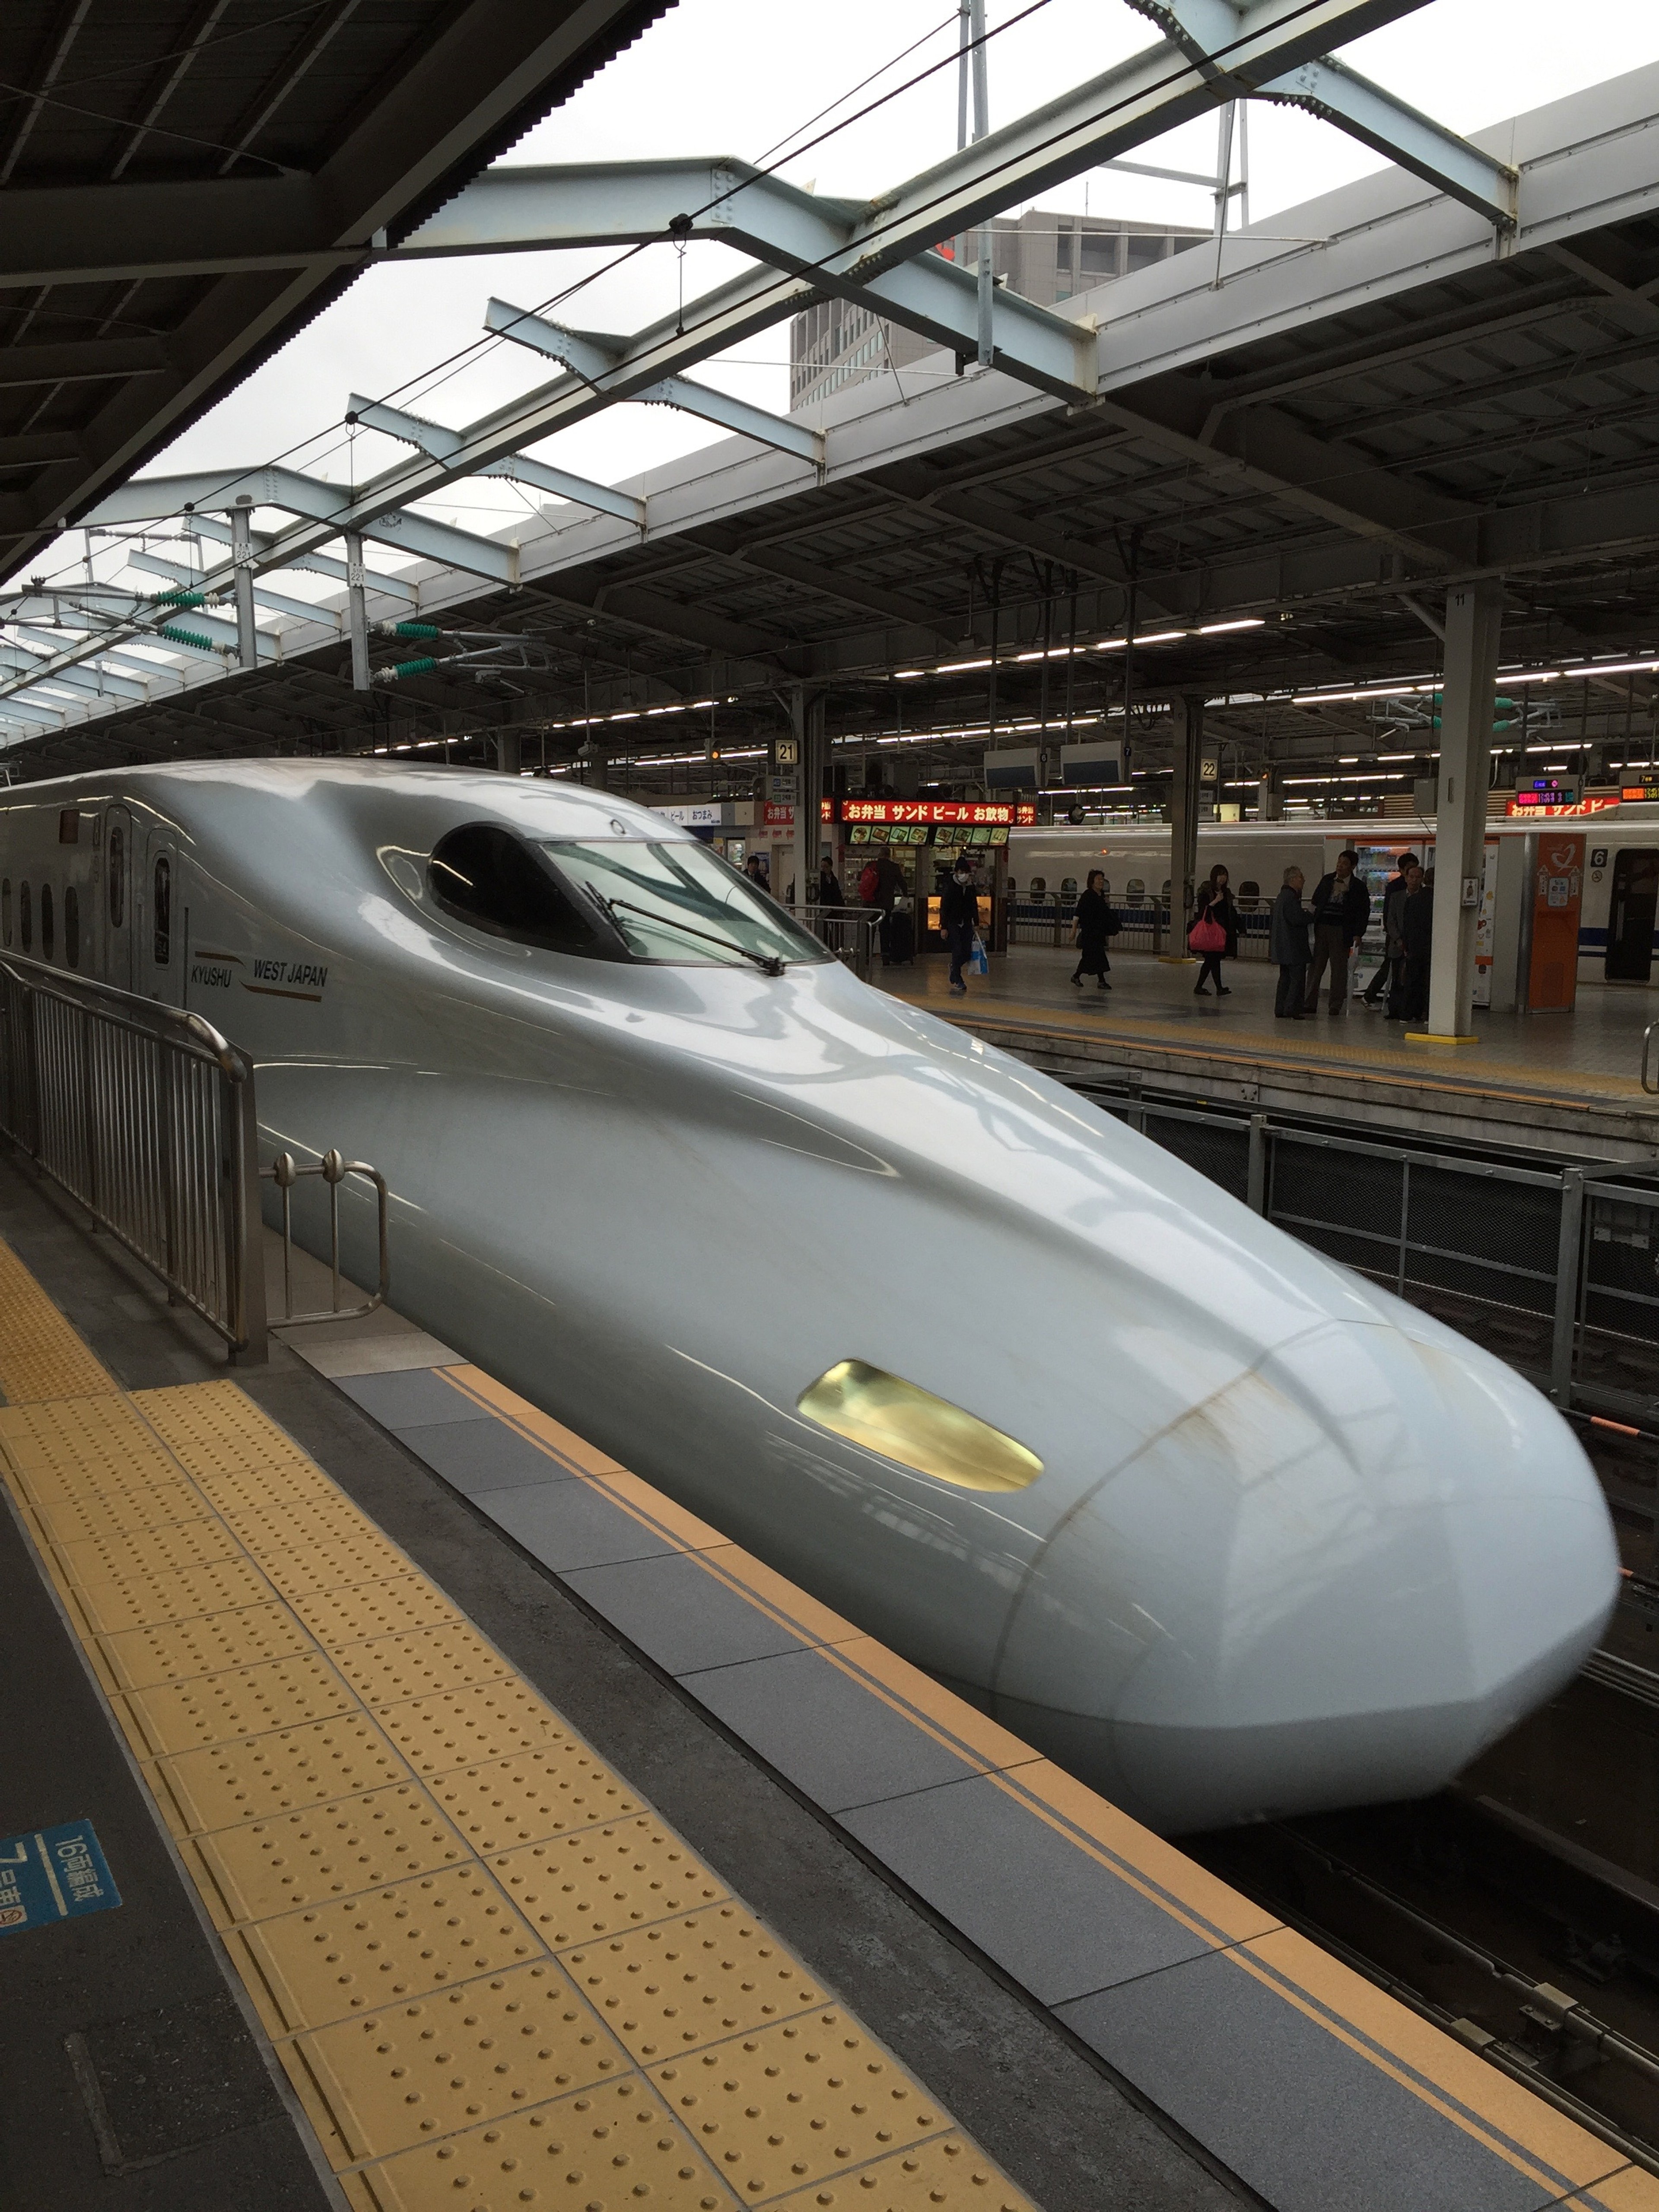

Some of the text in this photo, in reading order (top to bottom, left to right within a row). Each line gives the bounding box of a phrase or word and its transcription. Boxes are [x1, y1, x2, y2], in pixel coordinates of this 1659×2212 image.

[237, 550, 251, 559] 221
[351, 572, 364, 582] 221
[1455, 594, 1465, 606] 11
[780, 744, 792, 759] 21
[1204, 763, 1214, 776] 22
[693, 810, 712, 820] おつまみ
[767, 806, 786, 820] お弁当
[848, 804, 1009, 822] お弁当 サンド ビール お飲物
[1594, 851, 1604, 865] 6
[191, 964, 232, 988] KYUSHU
[254, 959, 327, 987] WEST JAPAN
[55, 1834, 104, 1902] 16両編成
